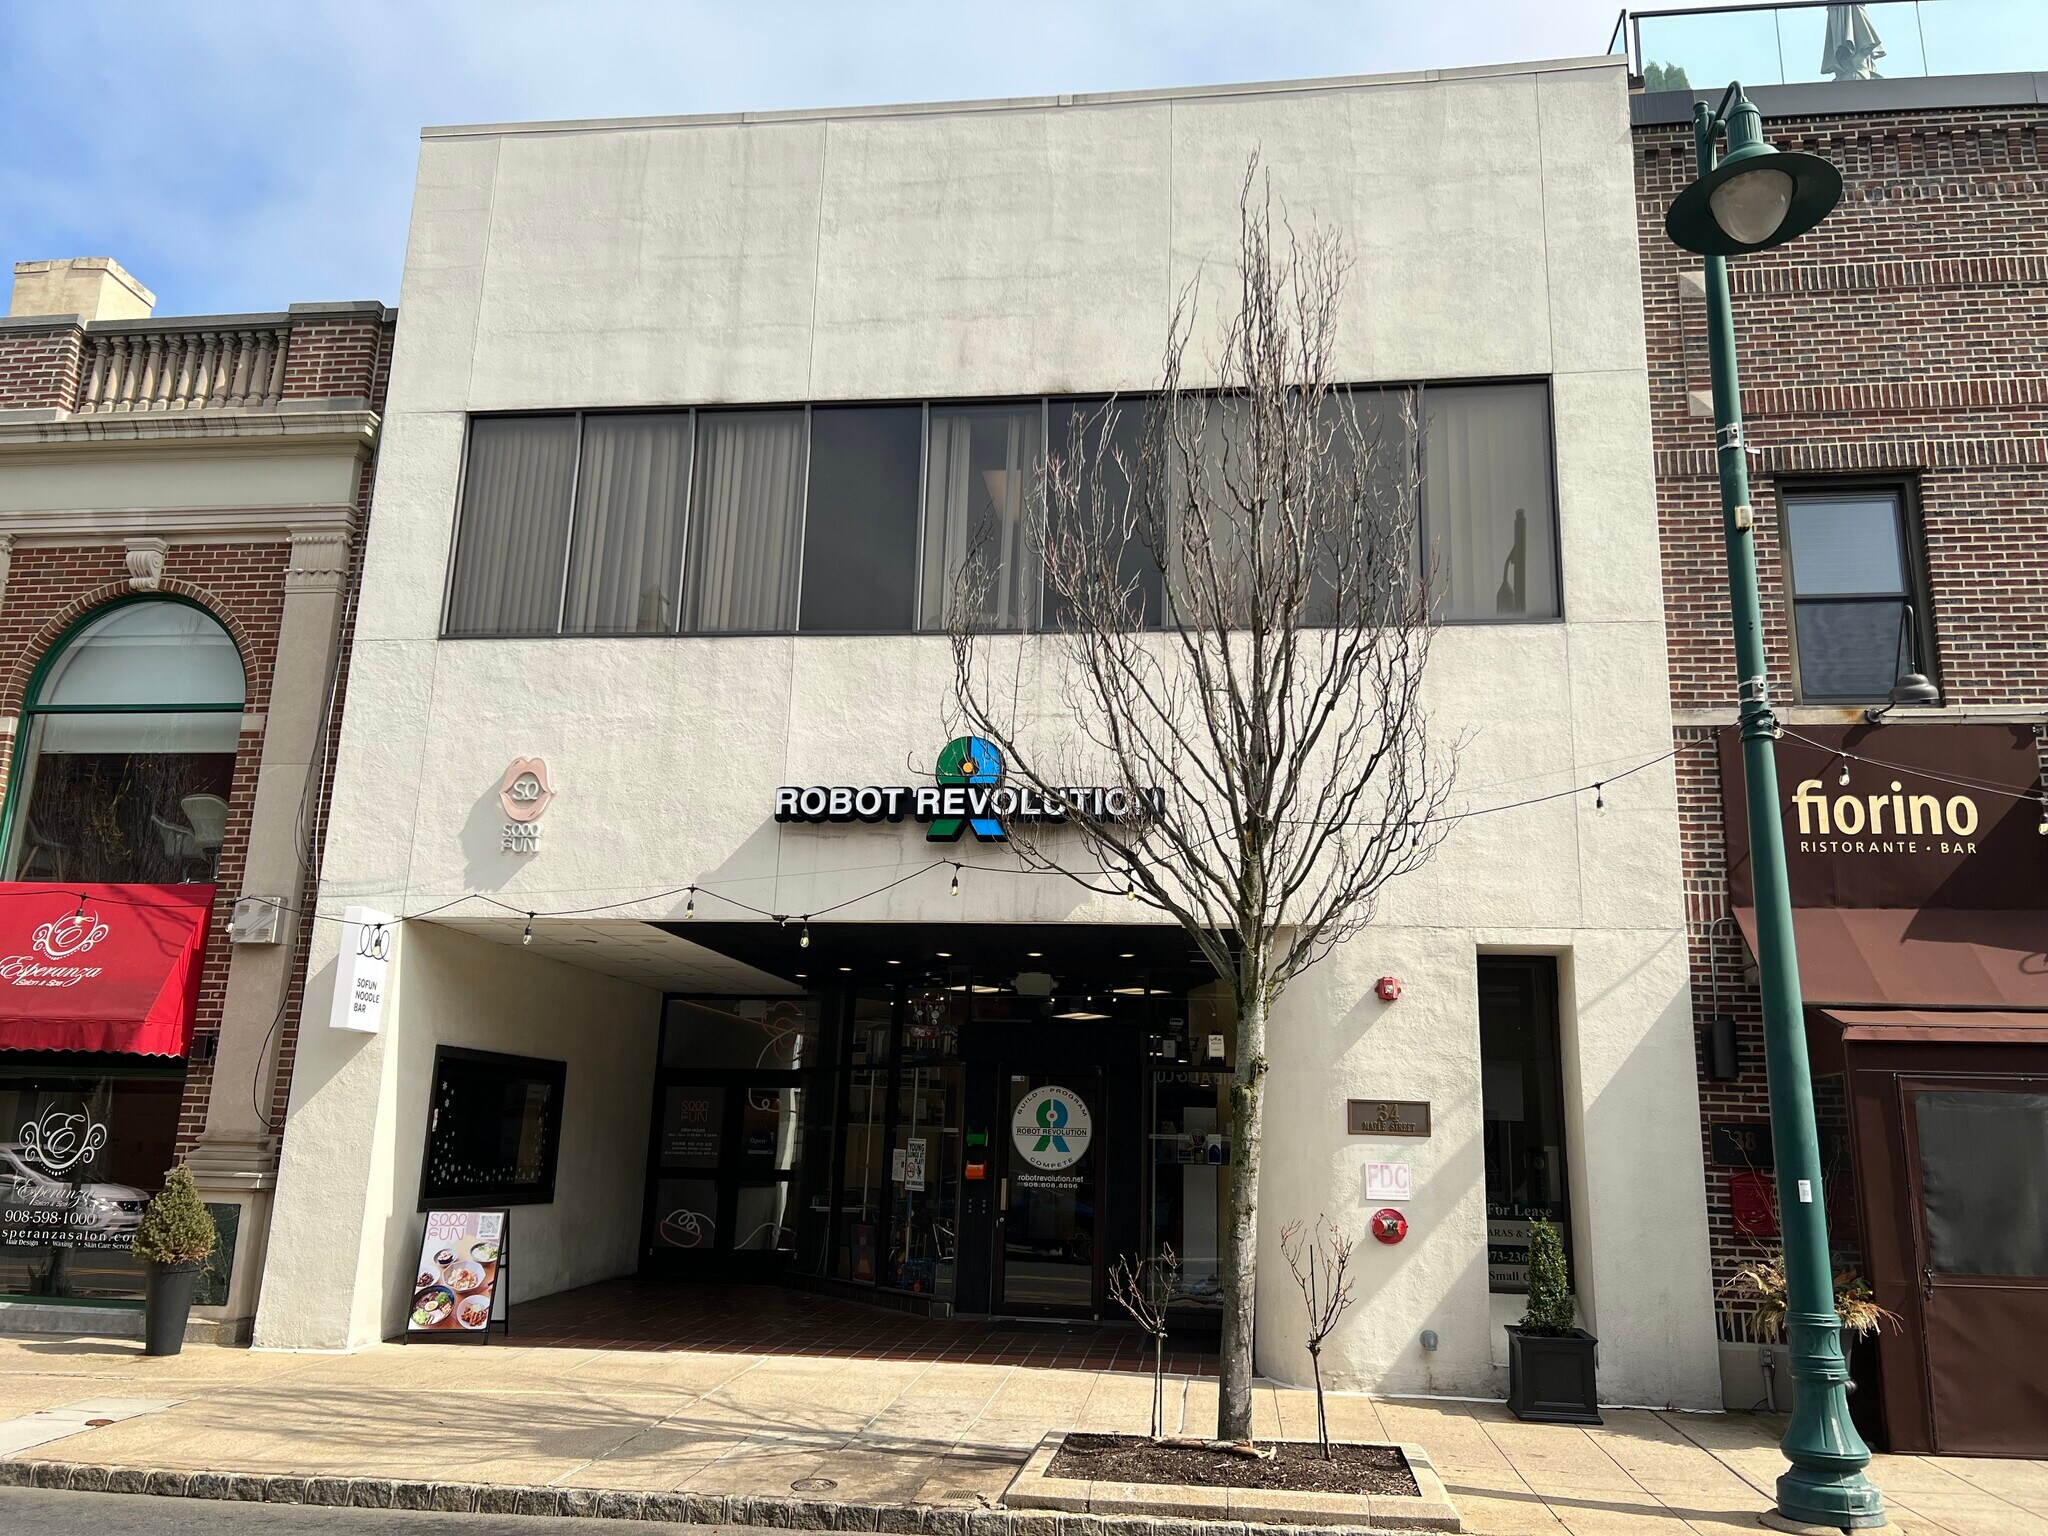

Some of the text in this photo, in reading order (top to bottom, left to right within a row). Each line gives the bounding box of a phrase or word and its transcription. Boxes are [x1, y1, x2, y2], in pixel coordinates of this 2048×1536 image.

[774, 786, 1165, 819] ROBOT REVOLUTION
[1791, 779, 1979, 836] fiorino
[501, 838, 541, 853] FUN
[1800, 841, 1977, 854] RISTORANTE BAR
[0, 955, 102, 987] Esperanza
[357, 978, 377, 990] SOFUN
[355, 991, 380, 1003] NOODLE
[354, 1003, 366, 1013] BAR
[1017, 1088, 1087, 1117] BUILD PROGRAM
[681, 1111, 708, 1122] FUN
[1377, 1104, 1399, 1121] 34
[1042, 1128, 1087, 1136] REVOLUTION
[1363, 1121, 1416, 1132] MAPLE STREET
[909, 1143, 925, 1152] YOUNG
[1029, 1157, 1074, 1168] COMPETE
[1018, 1174, 1084, 1183] robotrevolution.net
[1368, 1164, 1407, 1189] FDC
[14, 1178, 95, 1208] Esperanza
[1487, 1203, 1552, 1217] For Lease
[4, 1209, 95, 1225] 908-598-1000
[427, 1227, 465, 1241] FUN
[1516, 1229, 1523, 1238] &
[18, 1239, 39, 1247] Design
[1489, 1271, 1519, 1281] Small
